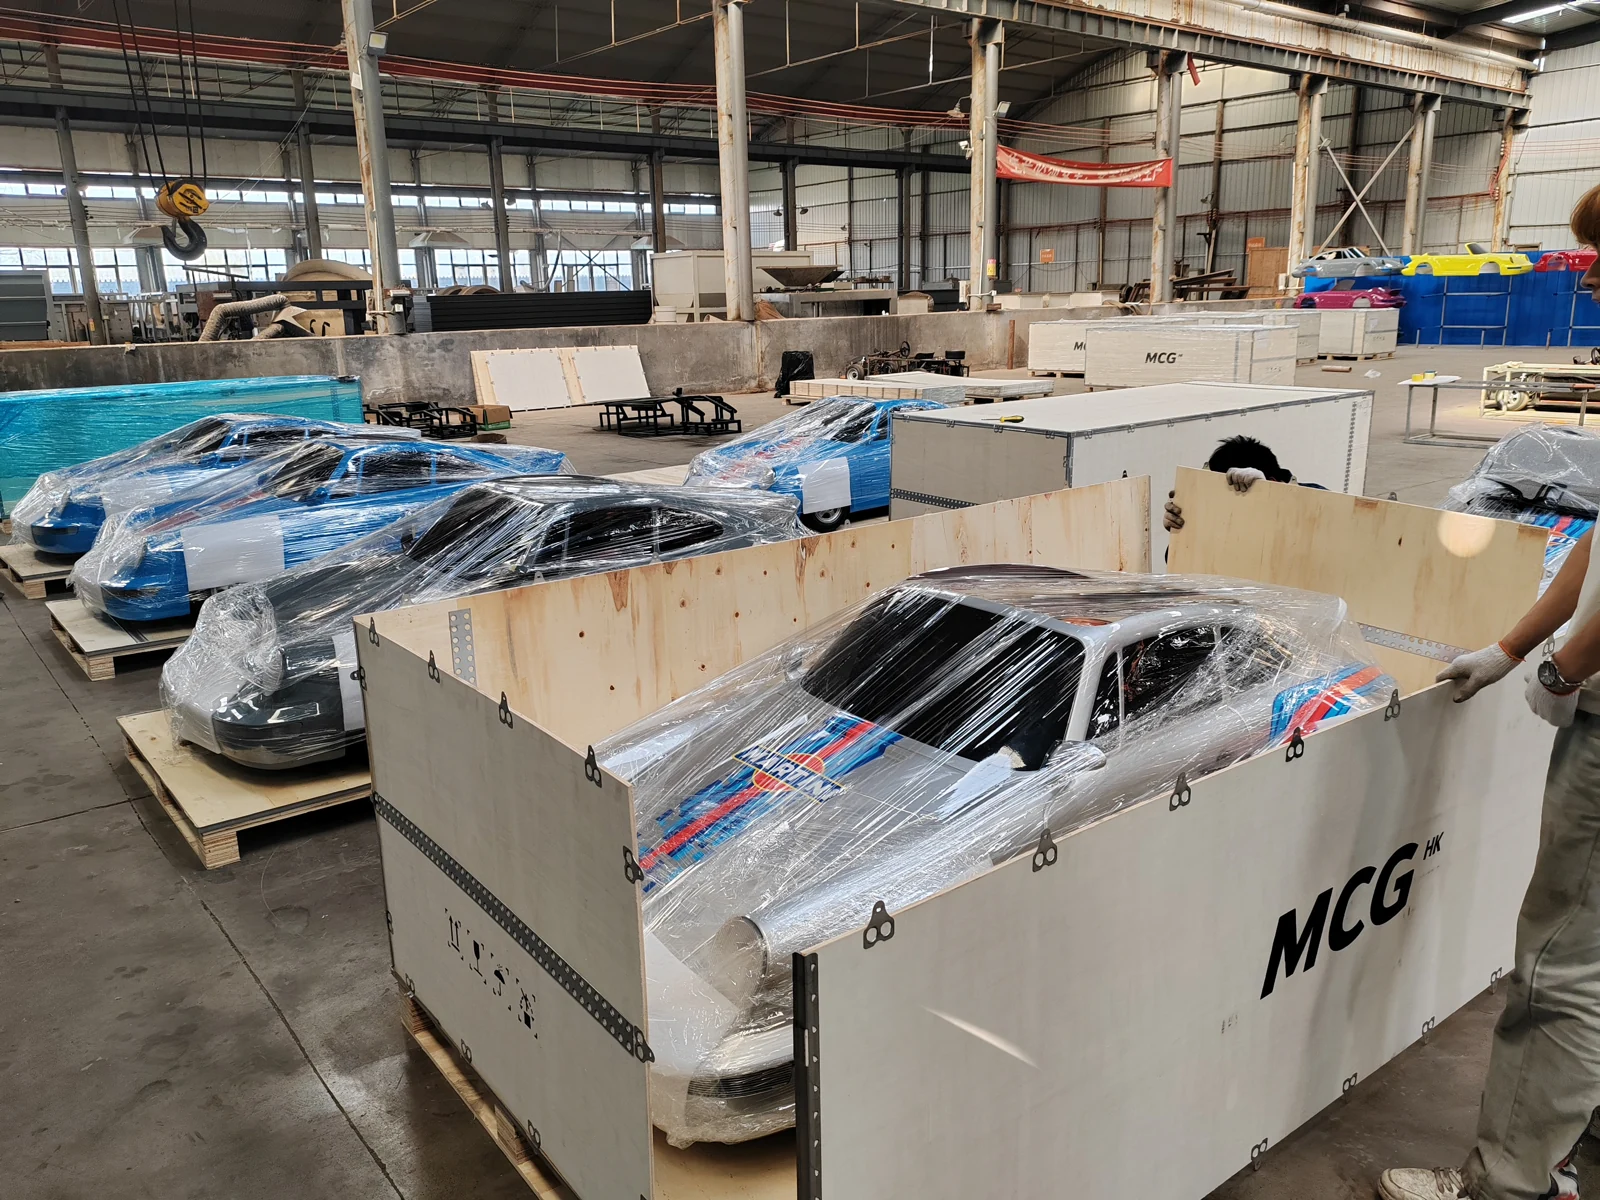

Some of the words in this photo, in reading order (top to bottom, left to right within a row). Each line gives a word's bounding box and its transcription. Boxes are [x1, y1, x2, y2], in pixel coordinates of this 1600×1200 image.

[1073, 341, 1086, 351] M
[1144, 352, 1177, 364] MCG
[1260, 842, 1419, 1000] MCG
[1422, 831, 1445, 861] HK
